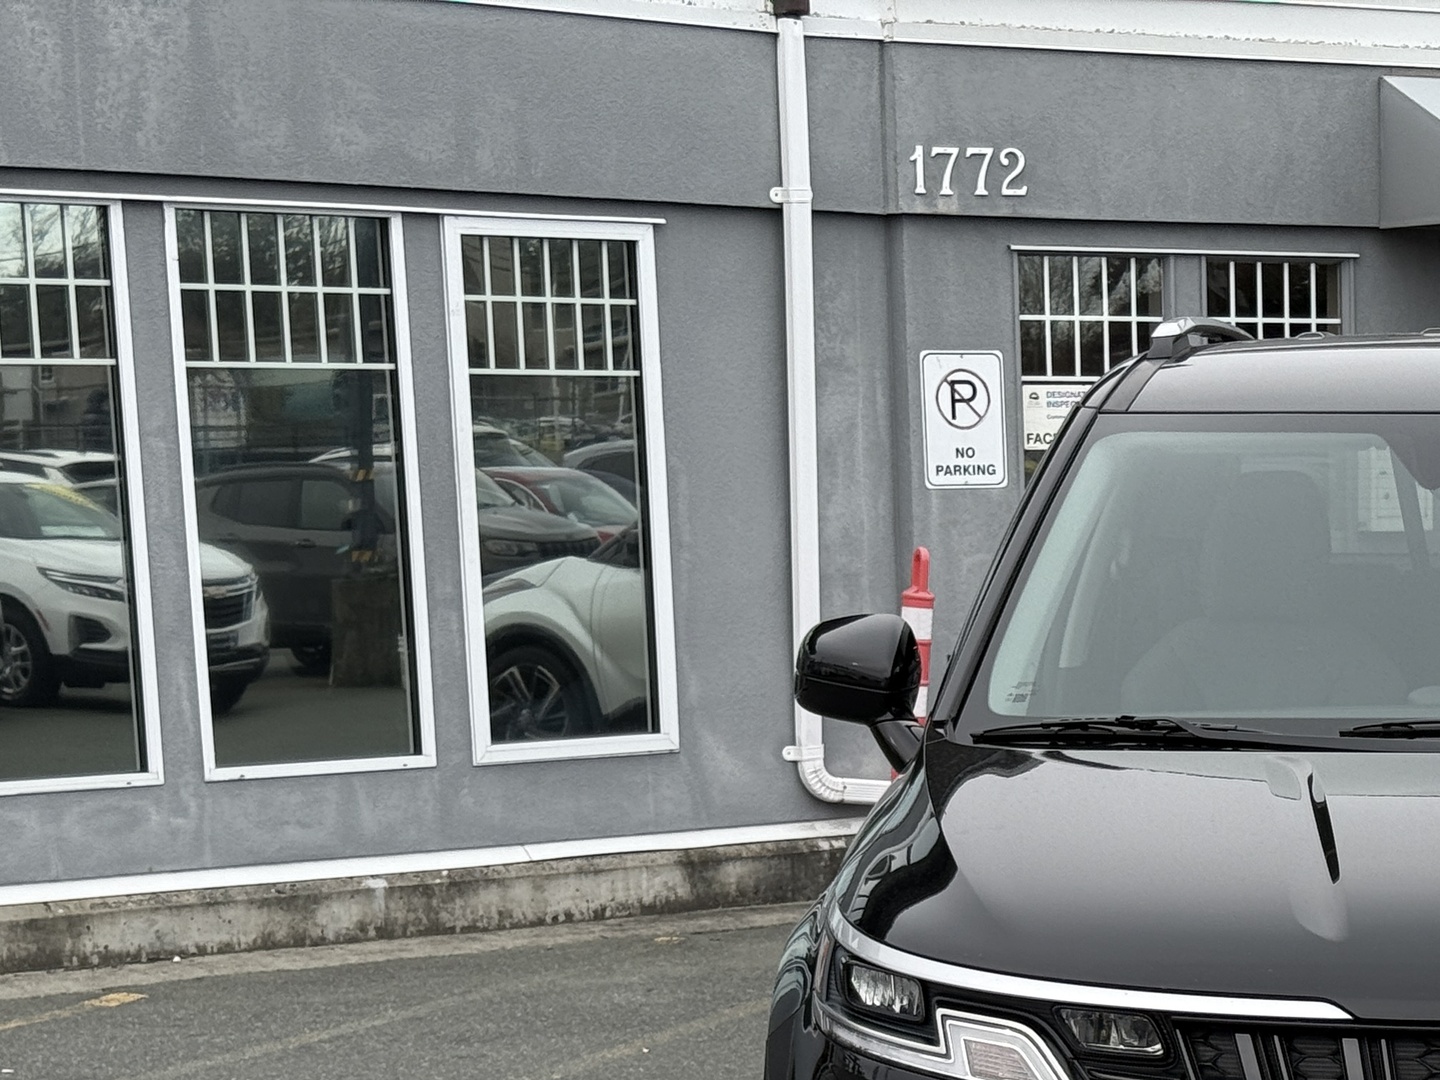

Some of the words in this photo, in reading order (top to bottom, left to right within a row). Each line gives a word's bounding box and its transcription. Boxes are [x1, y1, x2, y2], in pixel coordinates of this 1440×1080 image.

[909, 145, 1028, 196] 1772
[955, 447, 976, 459] NO
[935, 464, 997, 476] PARKING
